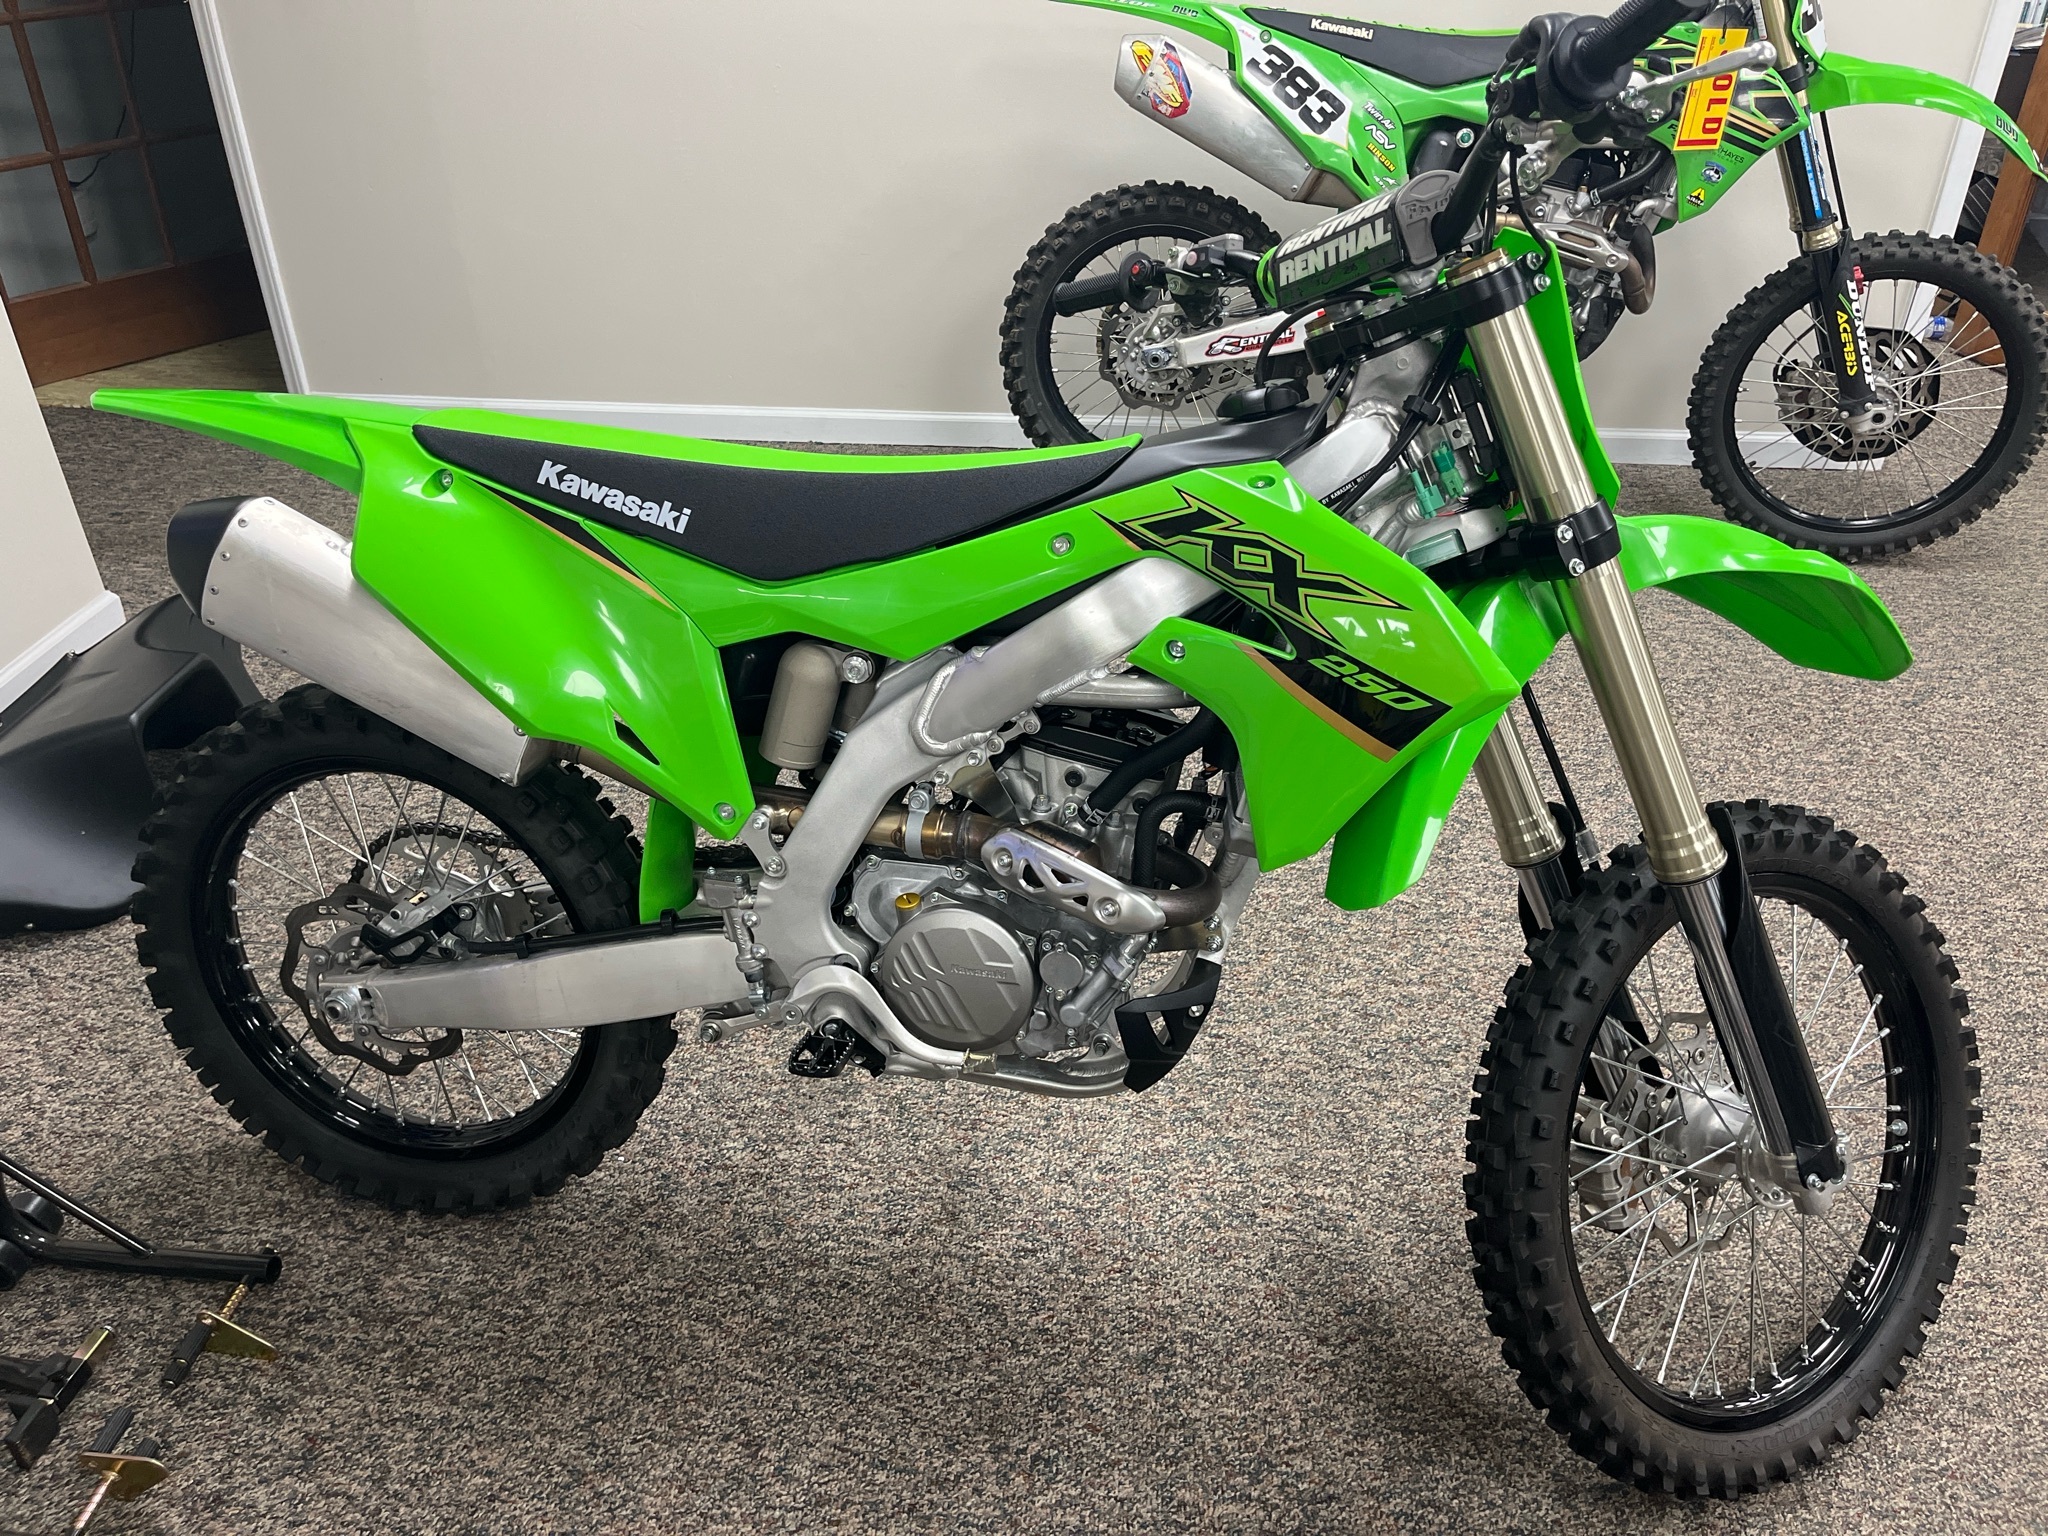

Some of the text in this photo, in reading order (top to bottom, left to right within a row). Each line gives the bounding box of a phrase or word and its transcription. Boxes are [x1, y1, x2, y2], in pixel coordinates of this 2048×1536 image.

[1310, 18, 1374, 40] Kawasaki
[1246, 44, 1346, 135] 383
[1363, 102, 1396, 131] Twin Air
[1702, 50, 1733, 135] OLD
[1364, 124, 1396, 150] ASV
[1366, 142, 1396, 172] HINSON
[1276, 193, 1394, 259] RENTHAL
[1279, 217, 1392, 288] RENTHAL
[1207, 328, 1294, 355] RENTAL
[1846, 279, 1876, 392] DUNLOP
[536, 459, 692, 535] Kawasaki
[1330, 481, 1355, 500] KAWASAKI
[1117, 486, 1414, 650] KX
[1307, 655, 1433, 712] 250
[950, 963, 1007, 980] Kawasaki
